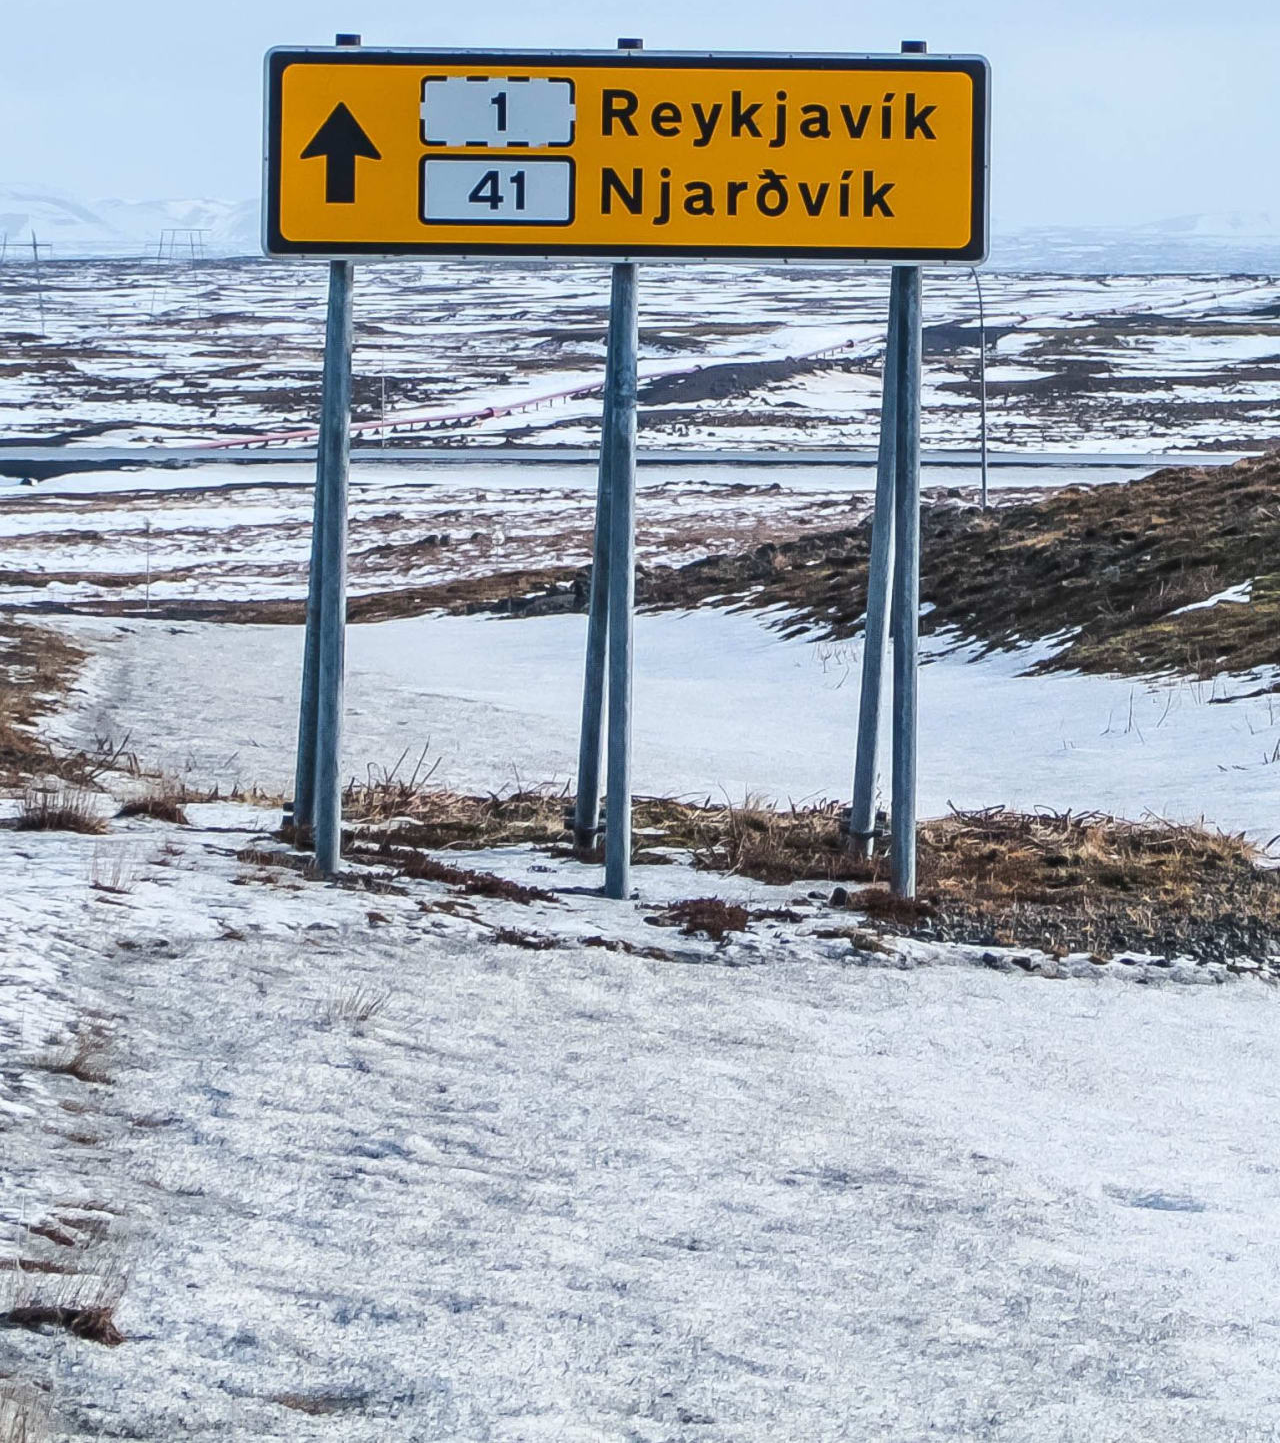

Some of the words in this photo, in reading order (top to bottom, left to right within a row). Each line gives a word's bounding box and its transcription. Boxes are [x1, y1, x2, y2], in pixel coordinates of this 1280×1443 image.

[491, 92, 507, 132] 1
[601, 88, 937, 148] Reykjavík
[468, 170, 525, 210] 41
[601, 167, 895, 226] Njarðvík
